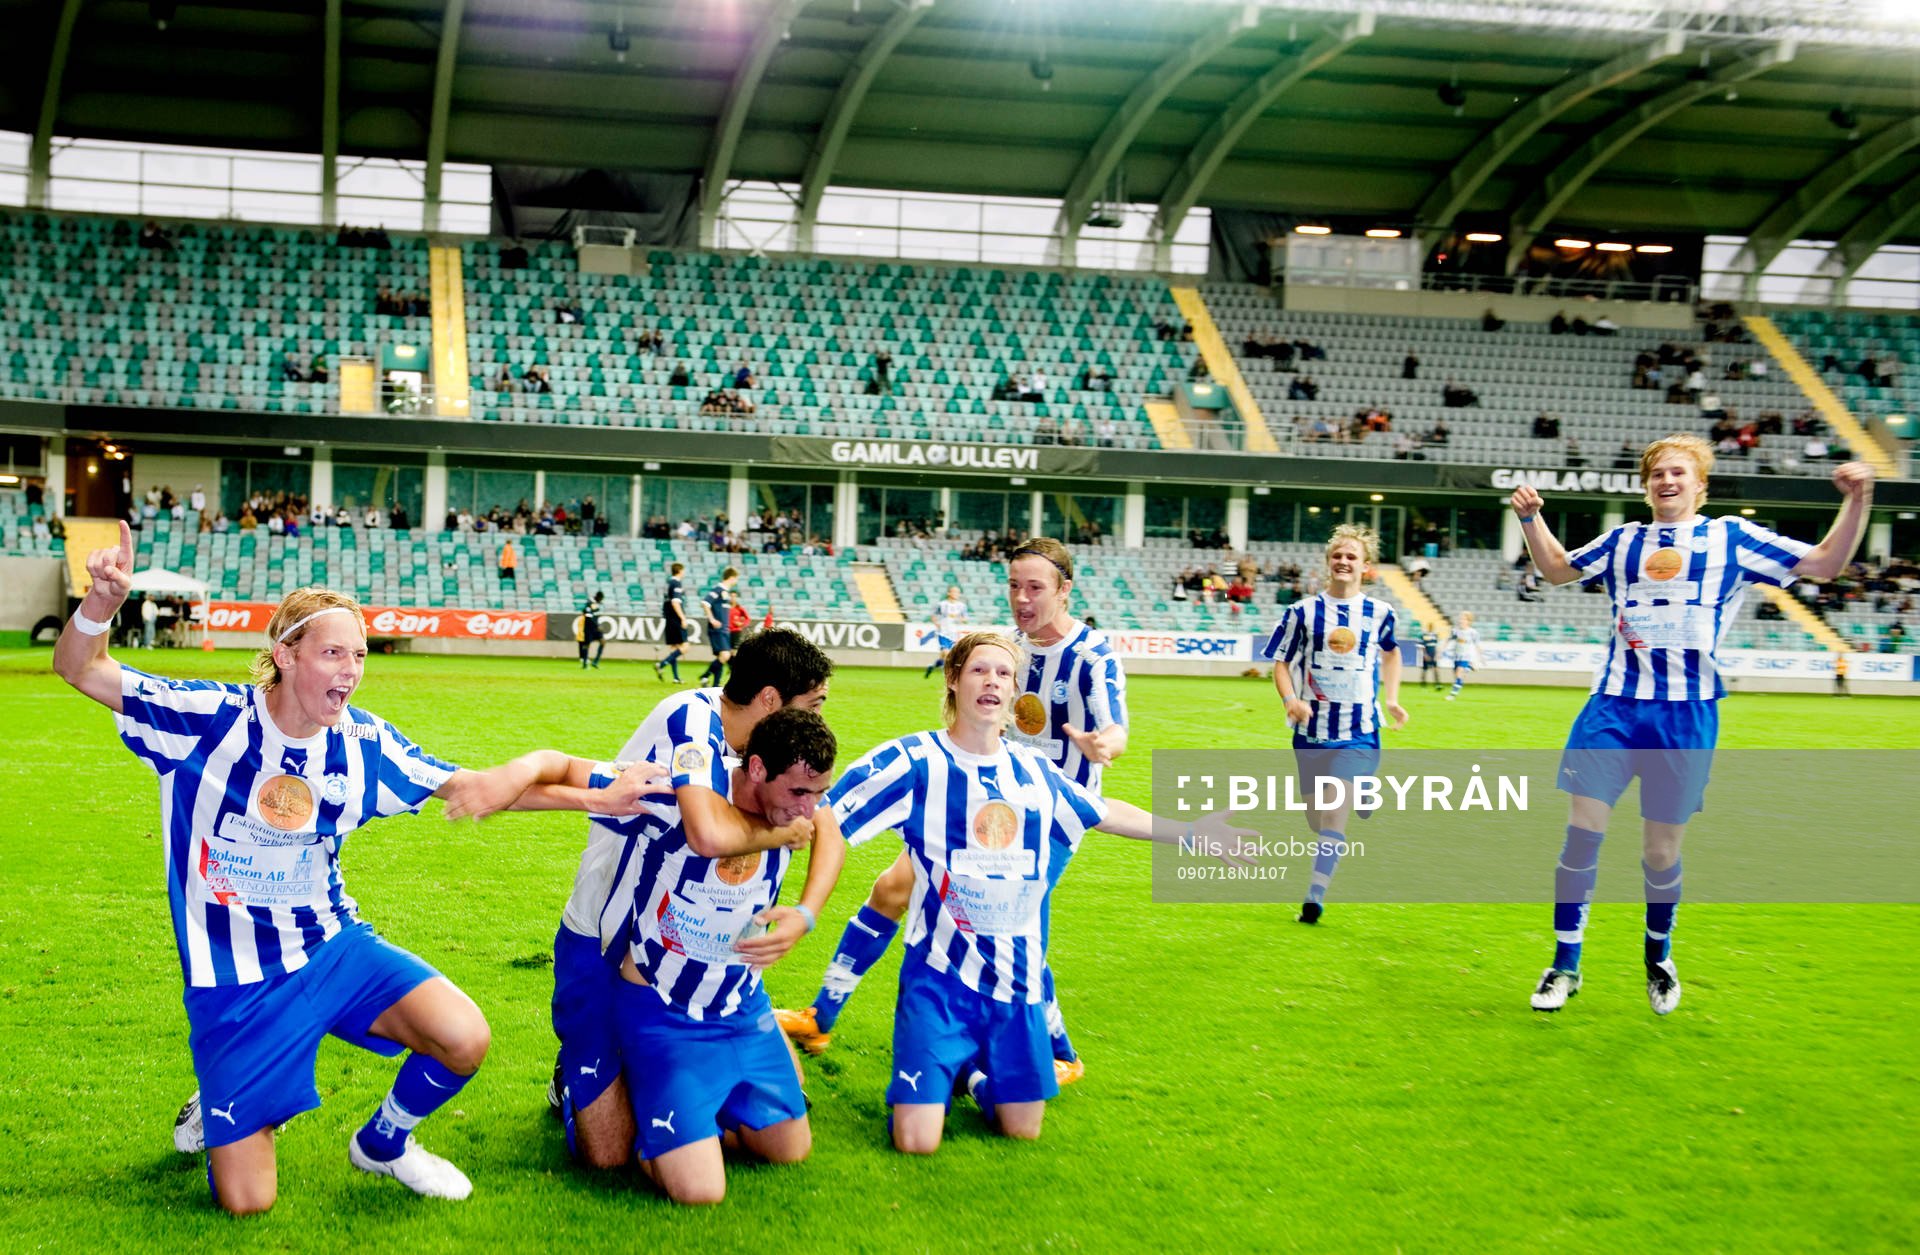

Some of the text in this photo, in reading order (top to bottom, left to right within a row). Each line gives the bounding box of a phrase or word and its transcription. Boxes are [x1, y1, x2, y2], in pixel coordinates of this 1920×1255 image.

[831, 442, 1039, 470] GAMLA ULLEVI
[1491, 469, 1648, 494] GAMLA ULL
[572, 615, 702, 643] OMVQ
[1112, 635, 1236, 655] INTERSPORT
[229, 815, 282, 840] Eskilstuna
[249, 831, 295, 847] Sparbank
[208, 848, 253, 866] Roland
[265, 871, 286, 882] AB
[948, 881, 986, 899] Roland
[667, 903, 706, 927] Roland
[716, 932, 731, 943] AB
